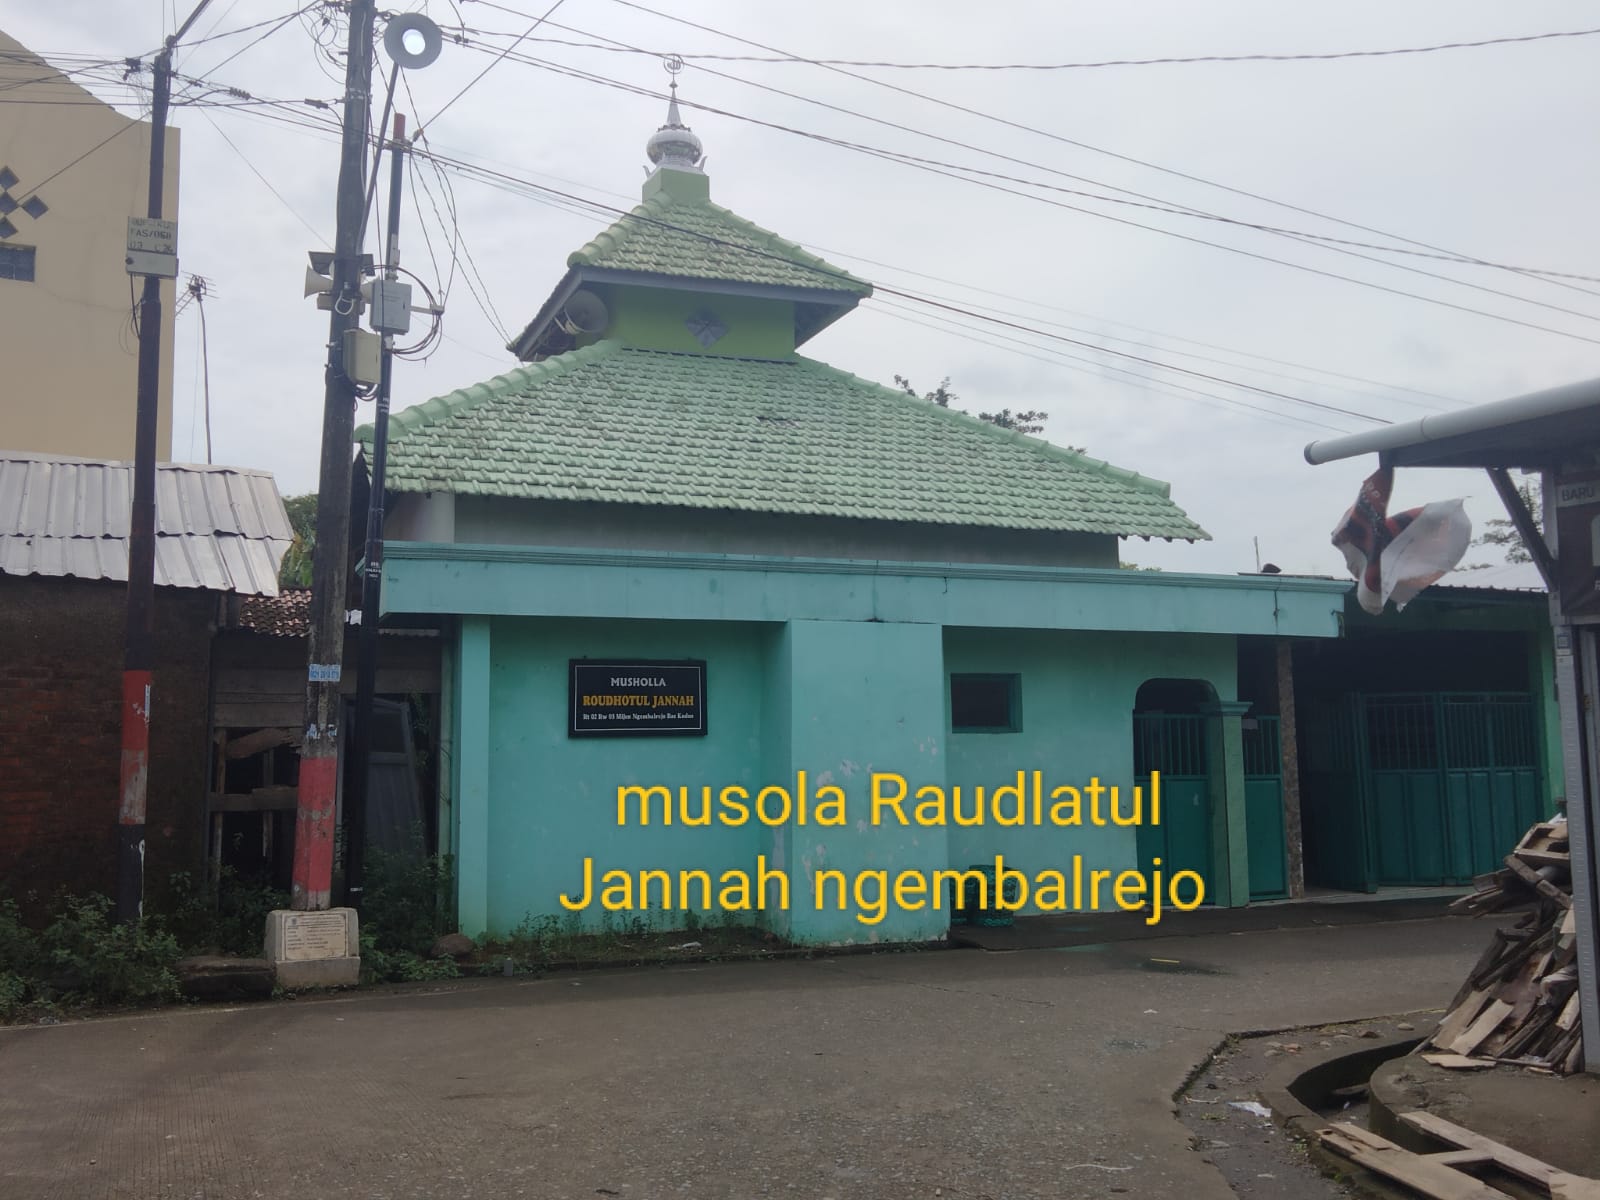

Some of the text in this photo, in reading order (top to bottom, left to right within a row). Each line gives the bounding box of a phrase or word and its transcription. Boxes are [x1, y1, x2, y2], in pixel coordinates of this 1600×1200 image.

[1562, 486, 1595, 501] BARU
[610, 677, 666, 687] MUSHOLLA
[582, 695, 694, 708] ROUDHOTUL JANNAH
[632, 712, 666, 721] Ngembalrejo
